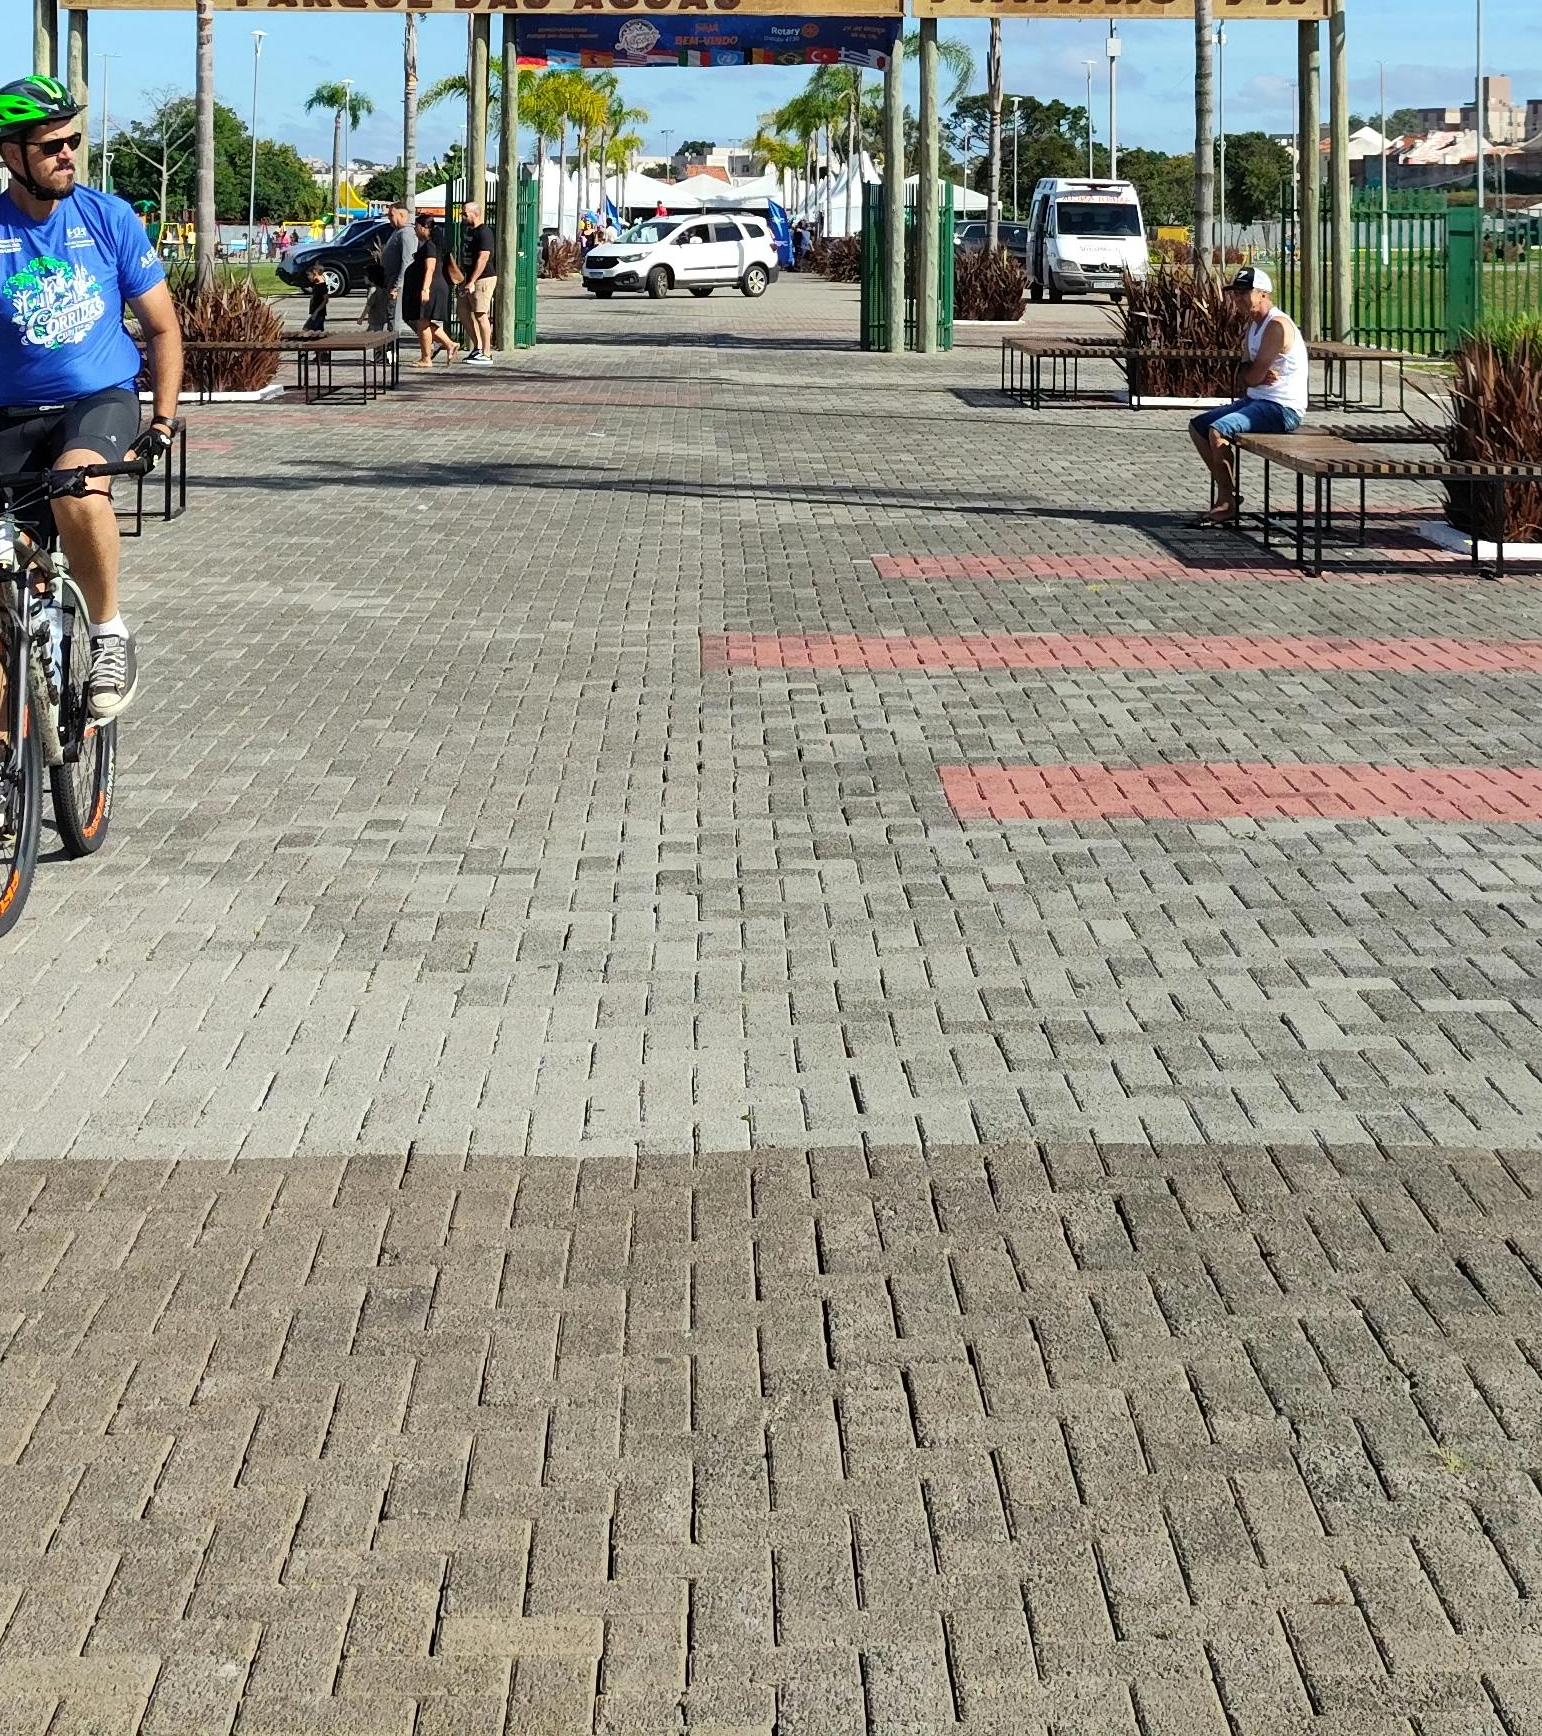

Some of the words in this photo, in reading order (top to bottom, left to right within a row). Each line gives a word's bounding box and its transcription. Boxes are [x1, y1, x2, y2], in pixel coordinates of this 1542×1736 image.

[771, 26, 801, 36] Rotary
[675, 35, 738, 46] BEM-VINDO
[26, 299, 105, 345] CORRIDAS
